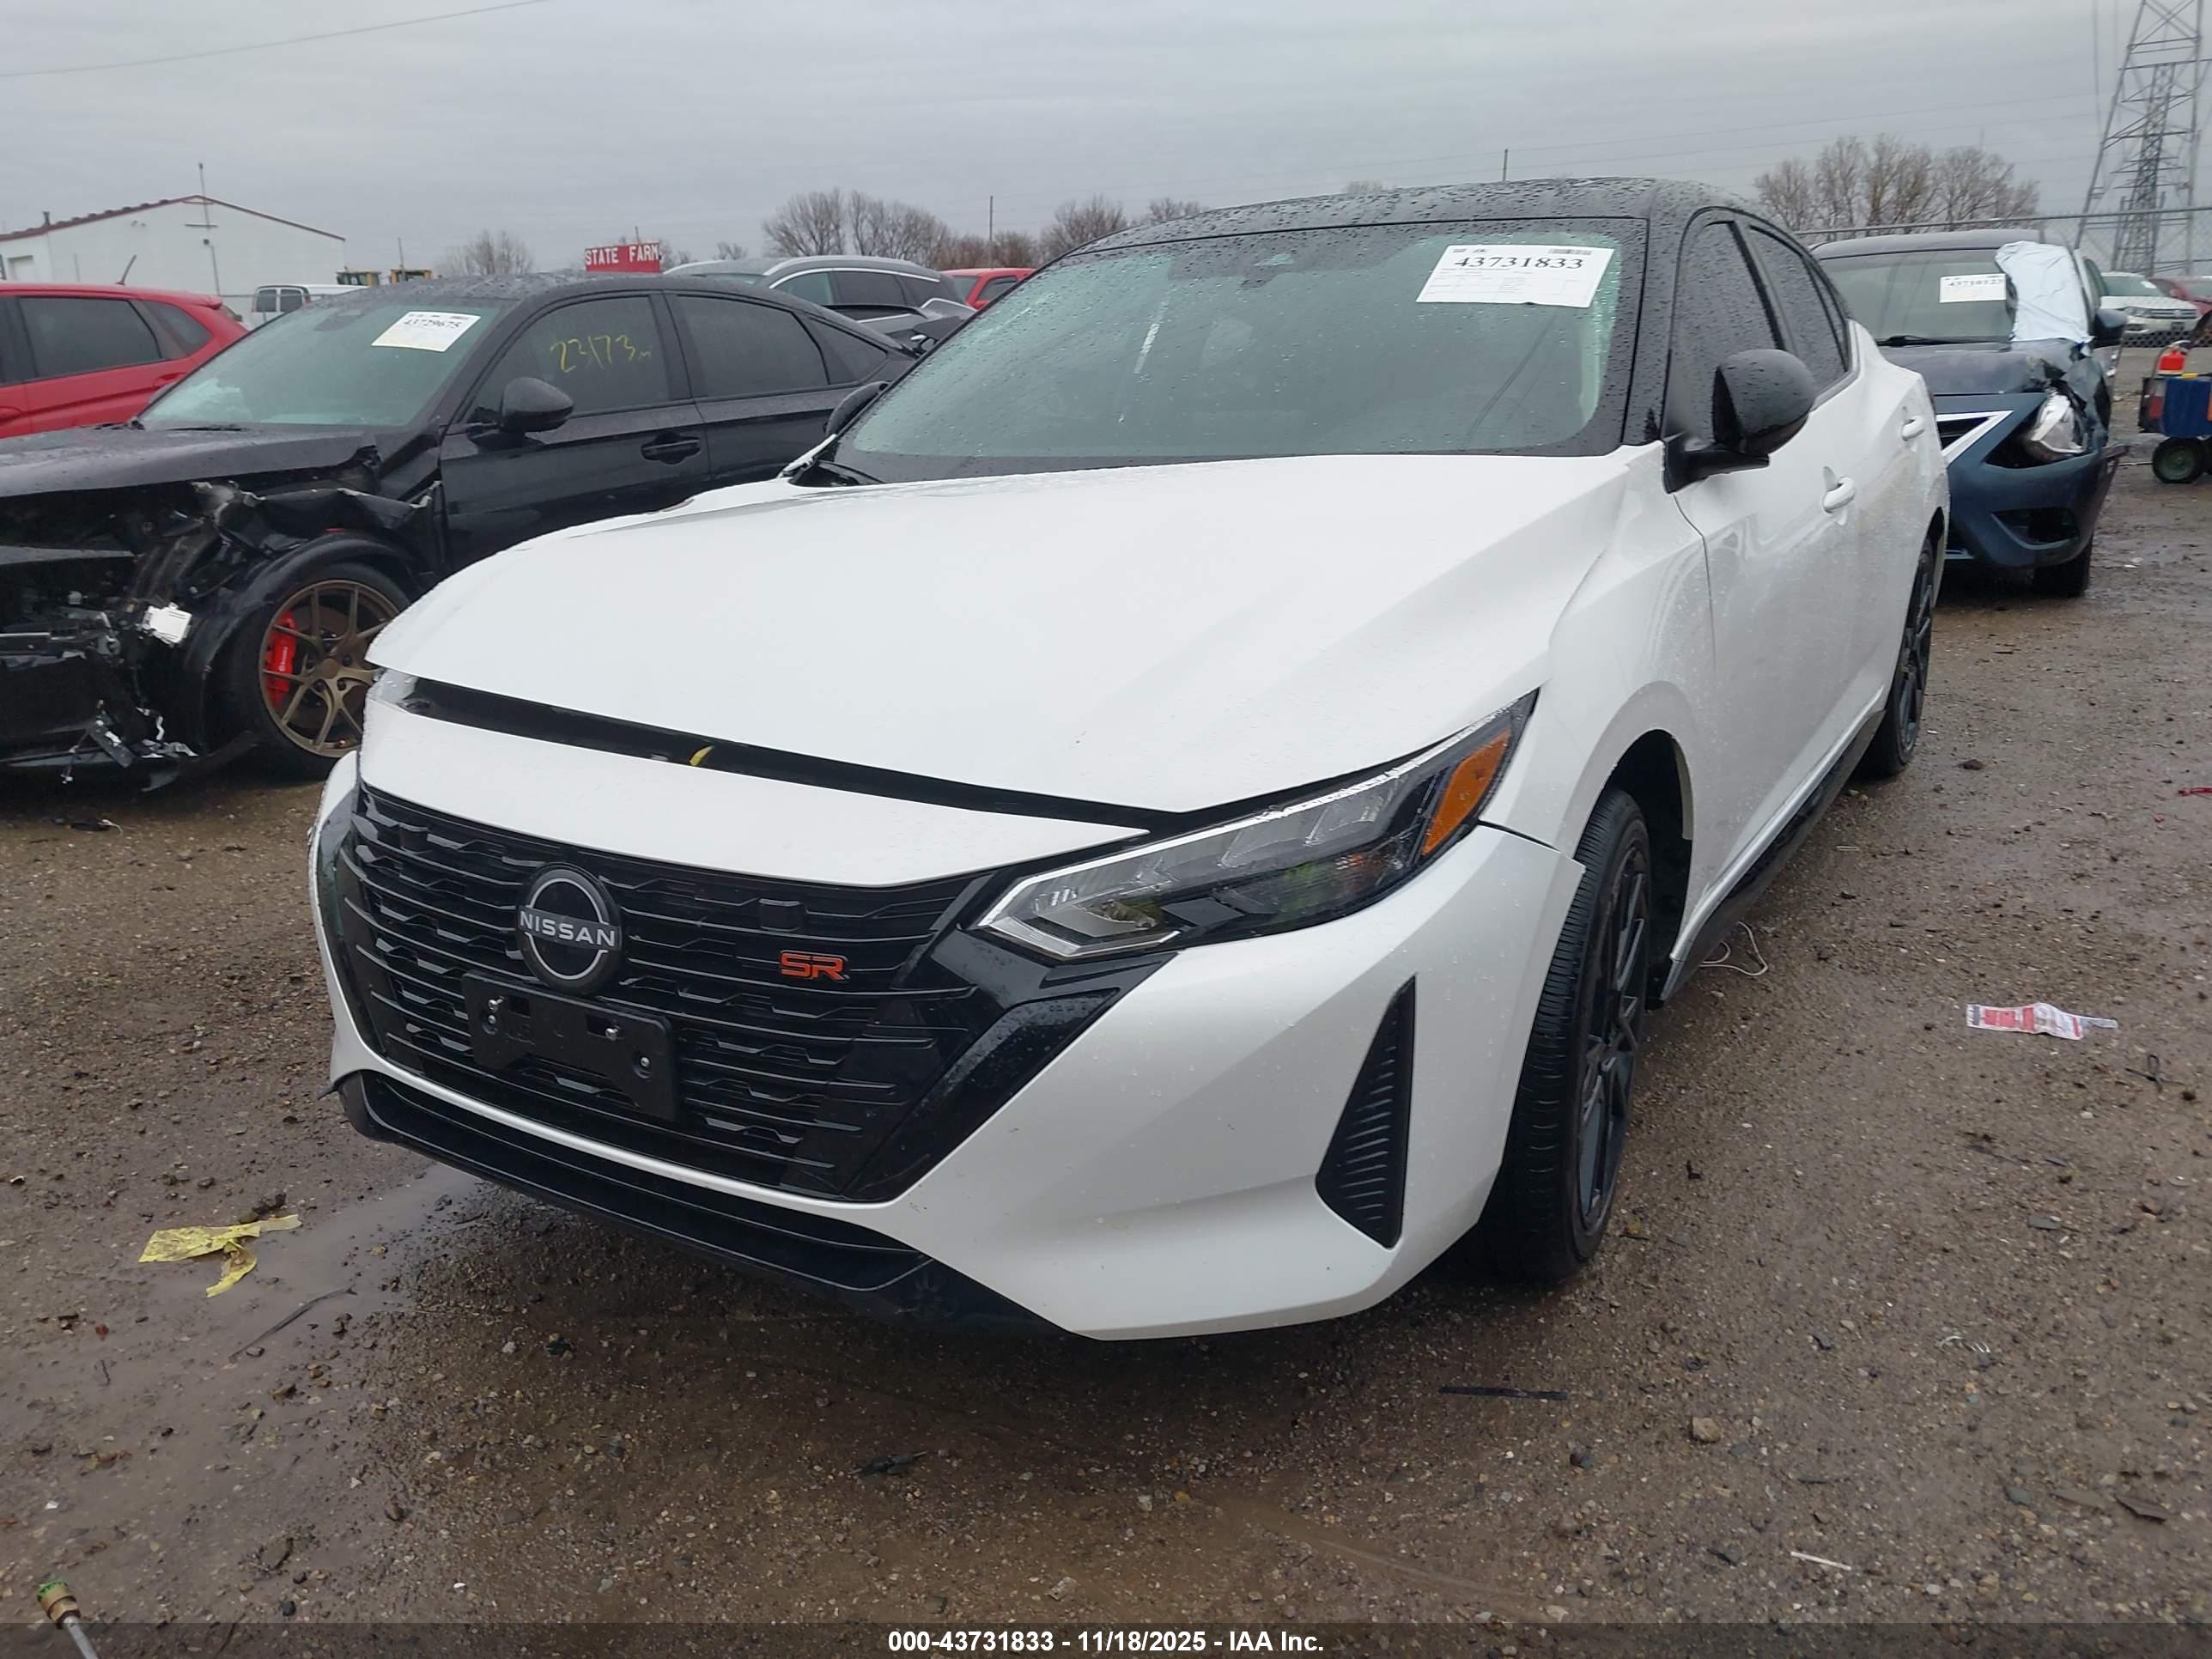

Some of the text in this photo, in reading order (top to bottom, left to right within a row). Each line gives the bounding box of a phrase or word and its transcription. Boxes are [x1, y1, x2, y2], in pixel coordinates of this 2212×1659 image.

[585, 245, 659, 265] STATE FARM
[1454, 257, 1584, 270] 43731833
[520, 910, 615, 946] NISSAN
[780, 950, 848, 981] SR
